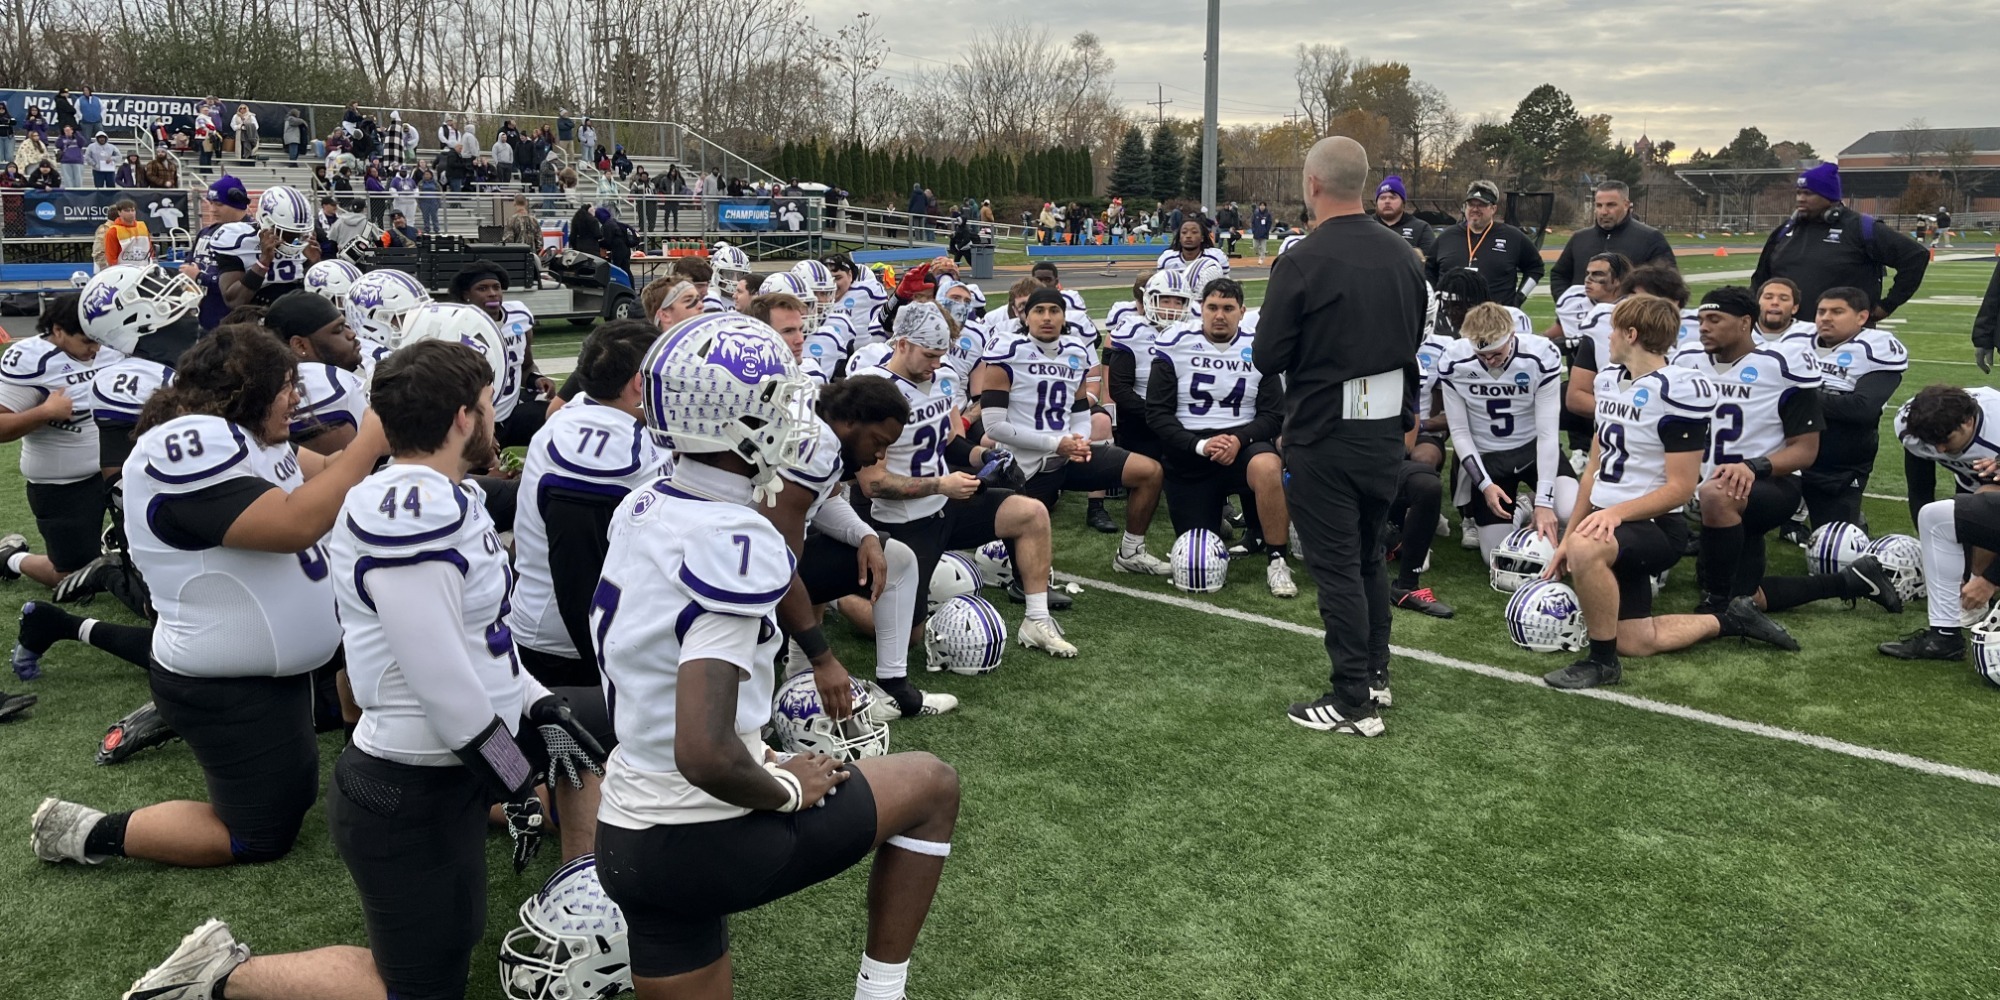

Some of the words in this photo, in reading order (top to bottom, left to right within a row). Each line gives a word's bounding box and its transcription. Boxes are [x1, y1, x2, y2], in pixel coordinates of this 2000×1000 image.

[123, 101, 200, 116] FOOTBAL
[63, 205, 109, 216] DIVISIO
[725, 209, 769, 219] CHAMPIONS
[2, 349, 22, 367] 23
[1548, 344, 1560, 359] 5
[1028, 363, 1076, 379] CROWN
[1191, 356, 1252, 372] CROWN
[113, 373, 140, 396] 24
[1741, 372, 1756, 380] NCAA
[1188, 372, 1246, 417] 54
[1469, 384, 1529, 397] CROWN
[1691, 379, 1712, 398] 10
[907, 397, 952, 425] CROWN
[1034, 380, 1067, 431] 18
[1598, 400, 1642, 422] CROWN
[669, 410, 676, 421] 7
[1486, 399, 1515, 437] 5
[165, 429, 204, 463] 63
[577, 427, 610, 458] 77
[378, 486, 422, 520] 44
[732, 534, 750, 577] 7
